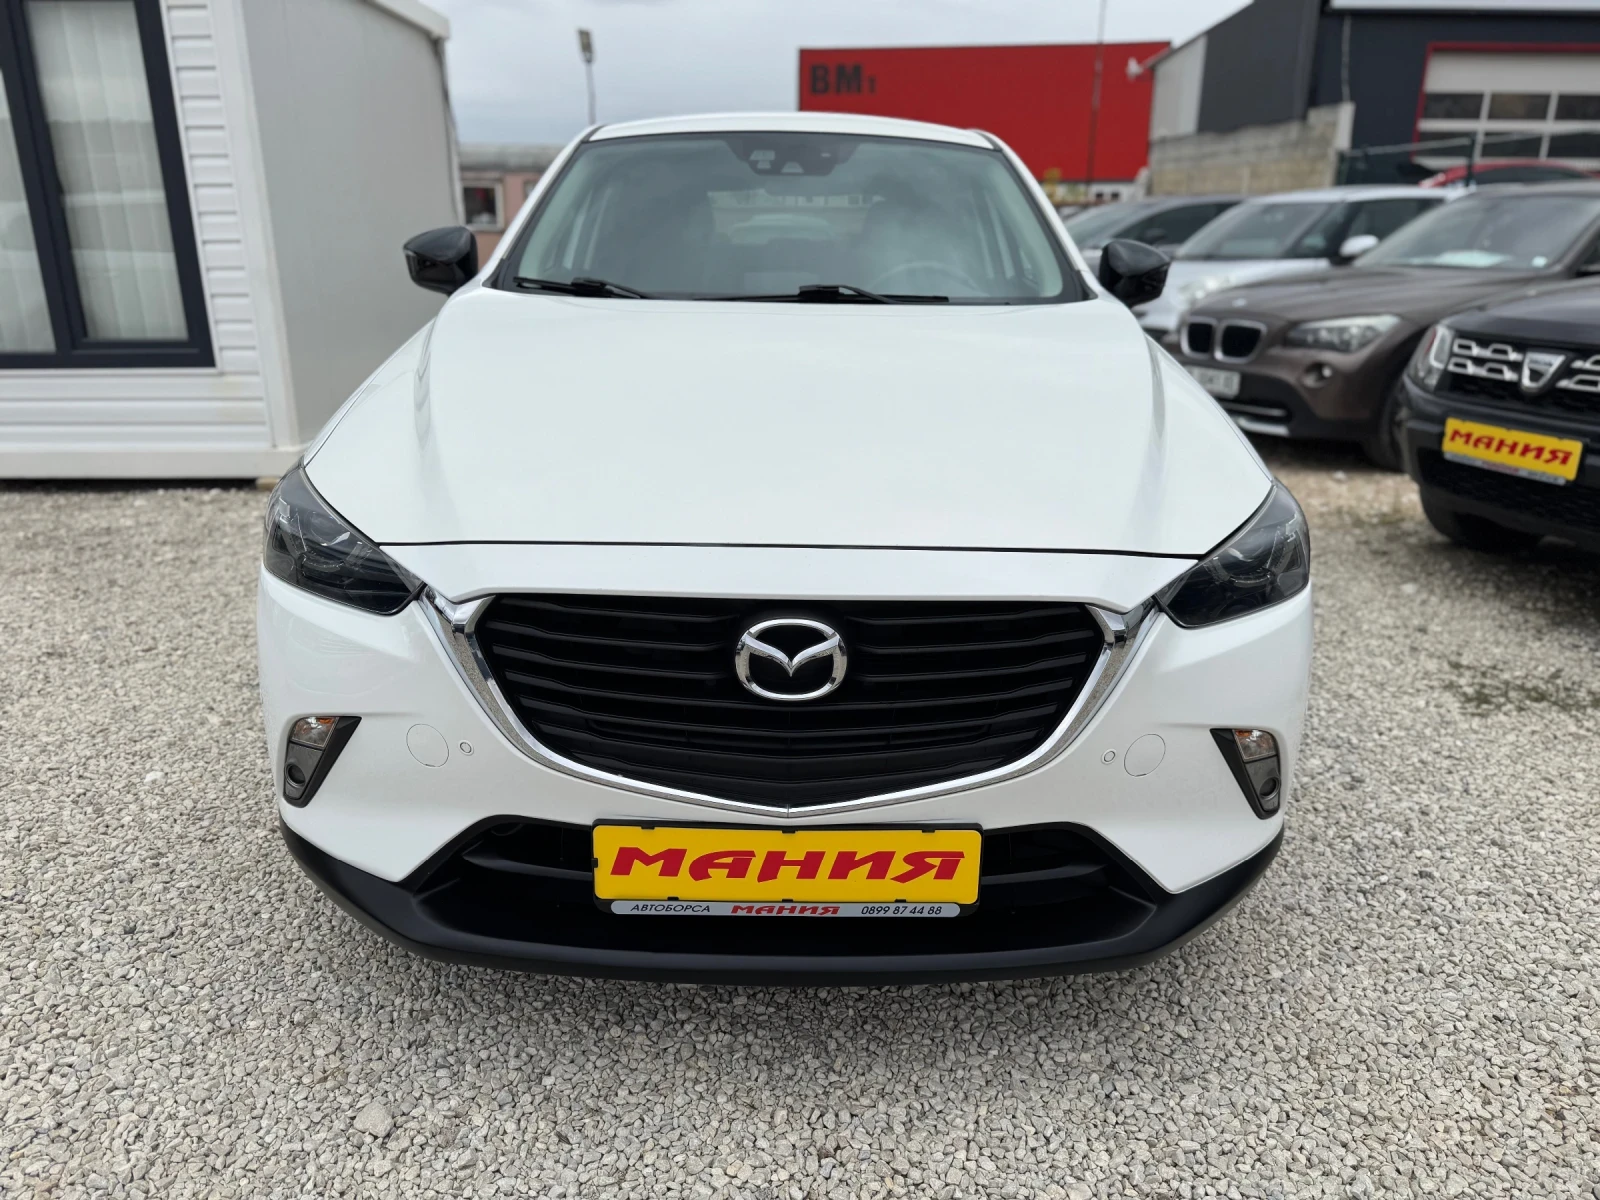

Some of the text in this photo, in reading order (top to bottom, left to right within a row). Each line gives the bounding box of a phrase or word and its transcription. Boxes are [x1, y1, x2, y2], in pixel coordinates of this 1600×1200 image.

[1450, 429, 1573, 466] МАНИЯ
[610, 846, 965, 884] МАНИЯ
[630, 904, 942, 916] АВТОБОРСА МАНИЯ 0899 87 44 88
